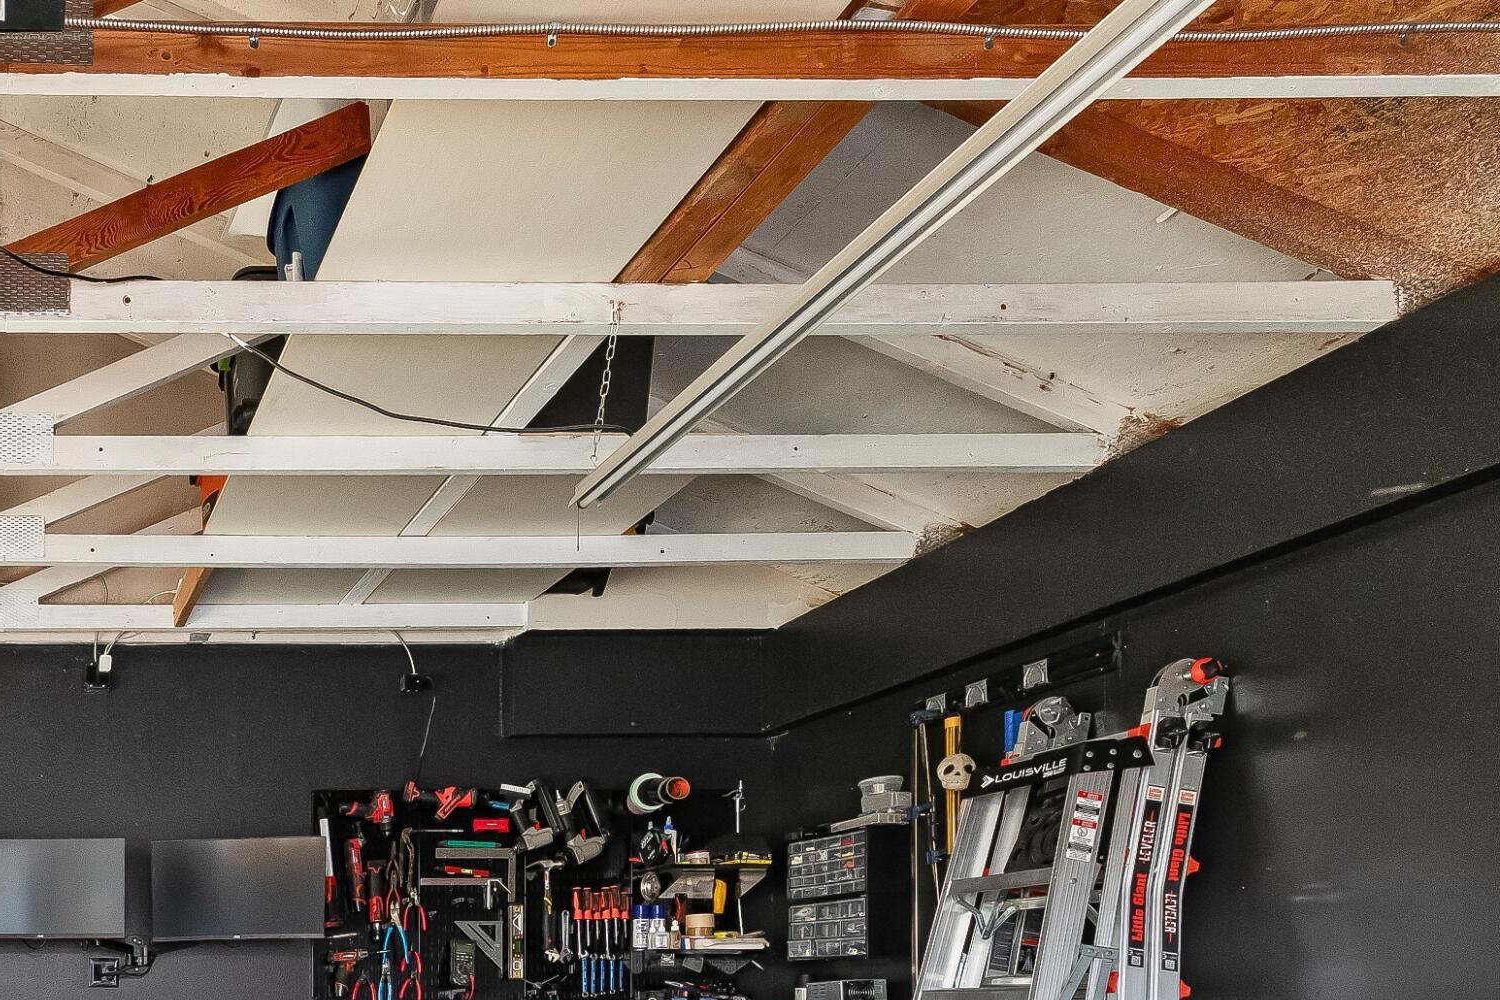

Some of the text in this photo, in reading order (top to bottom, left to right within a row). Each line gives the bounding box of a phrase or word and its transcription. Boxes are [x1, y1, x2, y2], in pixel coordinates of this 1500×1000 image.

[994, 757, 1068, 783] LOUISVILLE
[1138, 820, 1157, 862] LEVELER
[1168, 812, 1191, 881] Little Giant
[1132, 873, 1148, 906] Giant
[1131, 908, 1144, 942] Little
[1164, 893, 1177, 934] LEVELER
